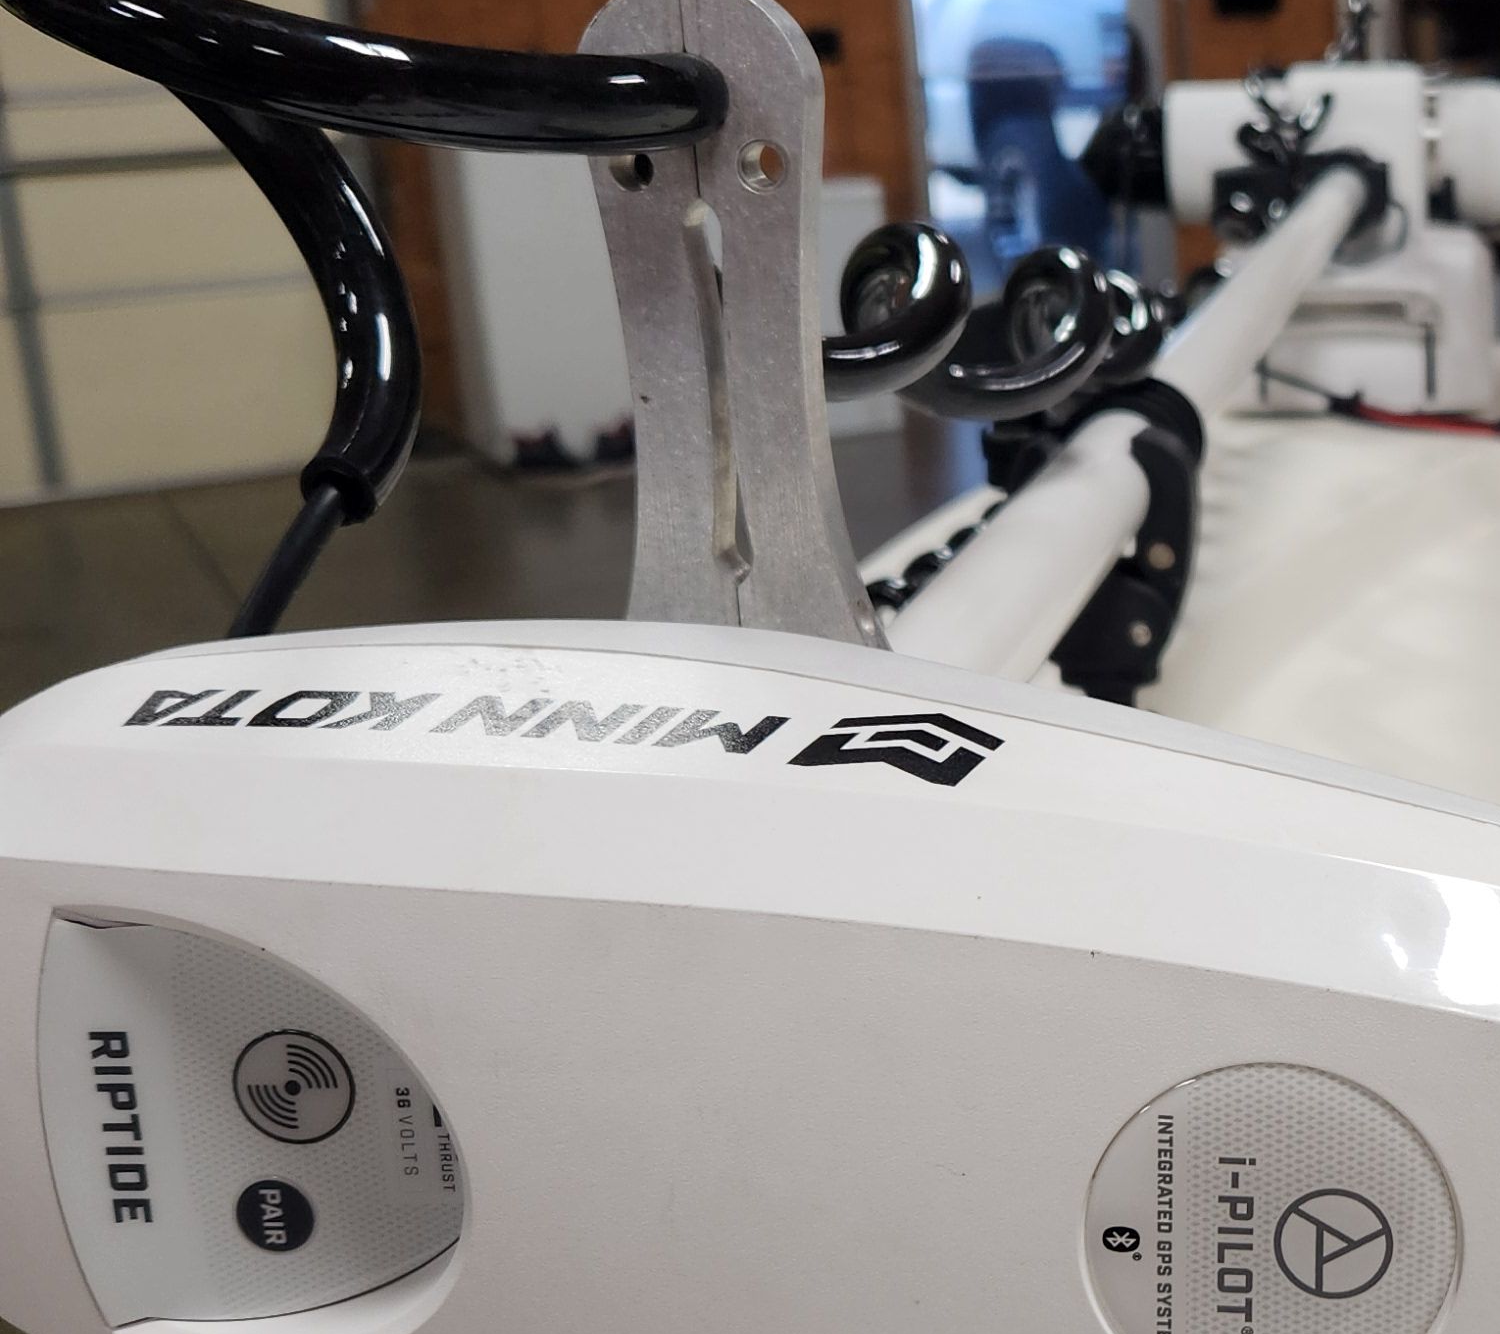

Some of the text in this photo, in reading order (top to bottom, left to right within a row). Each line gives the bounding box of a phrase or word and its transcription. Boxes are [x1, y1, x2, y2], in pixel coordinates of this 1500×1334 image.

[124, 688, 791, 755] MINN KOTA
[88, 1031, 153, 1223] RIPTIDE
[396, 1087, 419, 1176] 36 VOLTS
[438, 1133, 456, 1192] THRUST
[1156, 1114, 1174, 1234] INTEGRATED
[258, 1188, 287, 1245] PAIR
[1156, 1239, 1173, 1276] GPS
